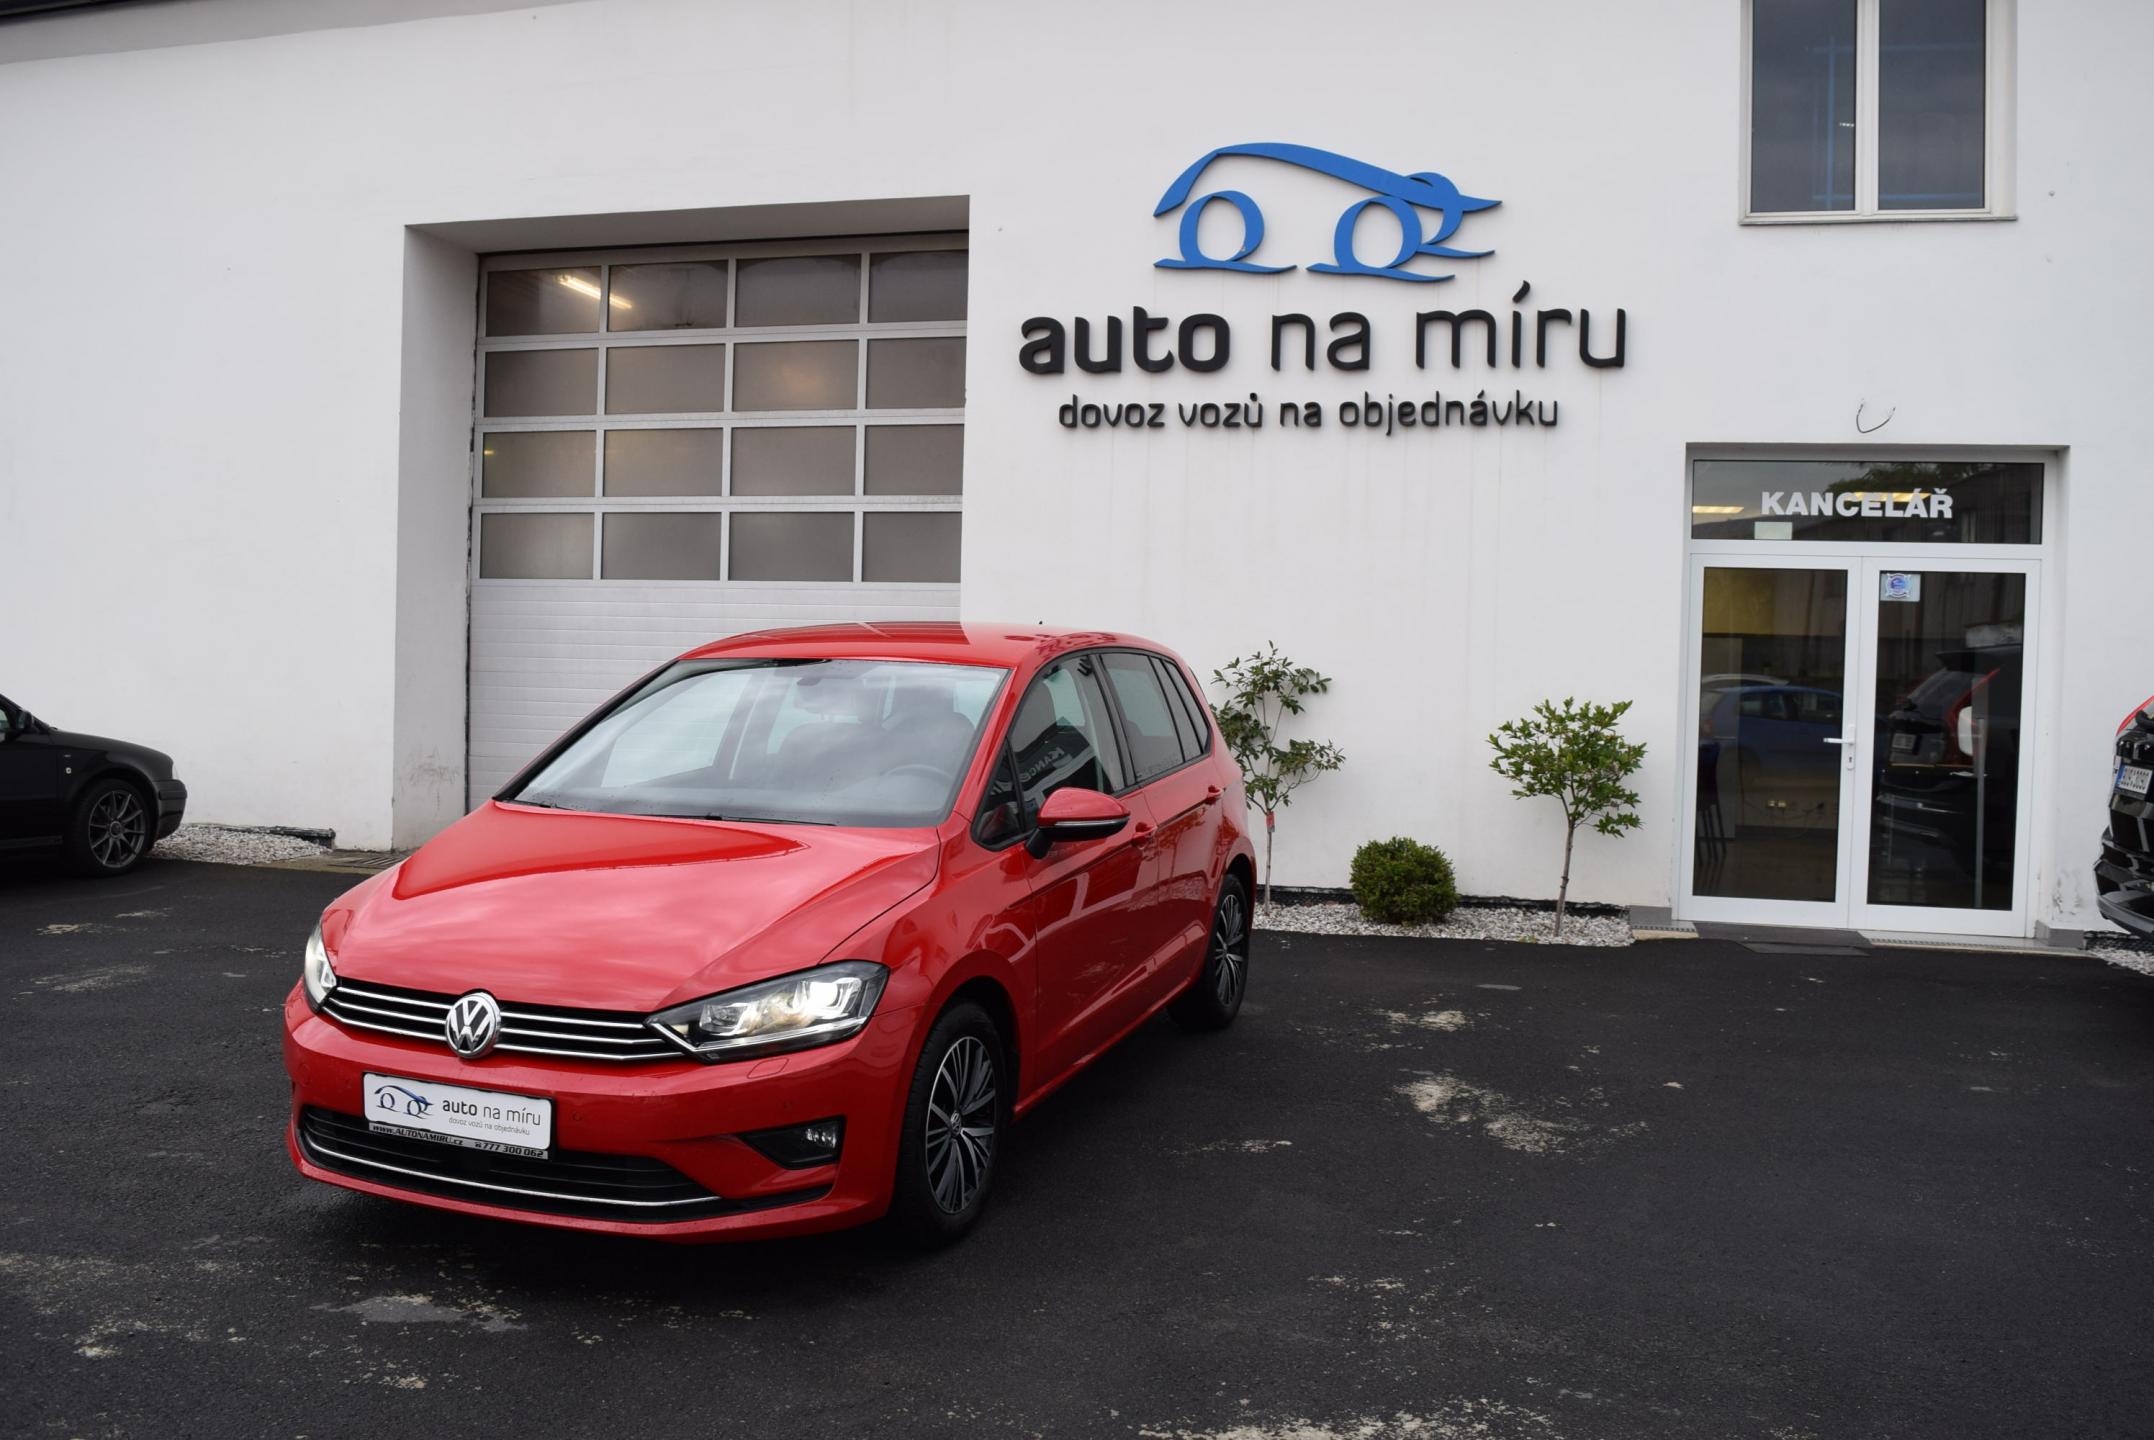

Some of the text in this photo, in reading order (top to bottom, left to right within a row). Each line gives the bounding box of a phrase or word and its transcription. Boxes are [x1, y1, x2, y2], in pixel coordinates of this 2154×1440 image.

[1019, 280, 1627, 374] auto na míru
[1059, 389, 1558, 436] dovoz vozů na objednávku
[1761, 487, 1954, 519] KANCELÁŘ
[442, 1099, 541, 1126] auto na míru
[502, 1144, 522, 1155] 300
[523, 1148, 544, 1158] 062
